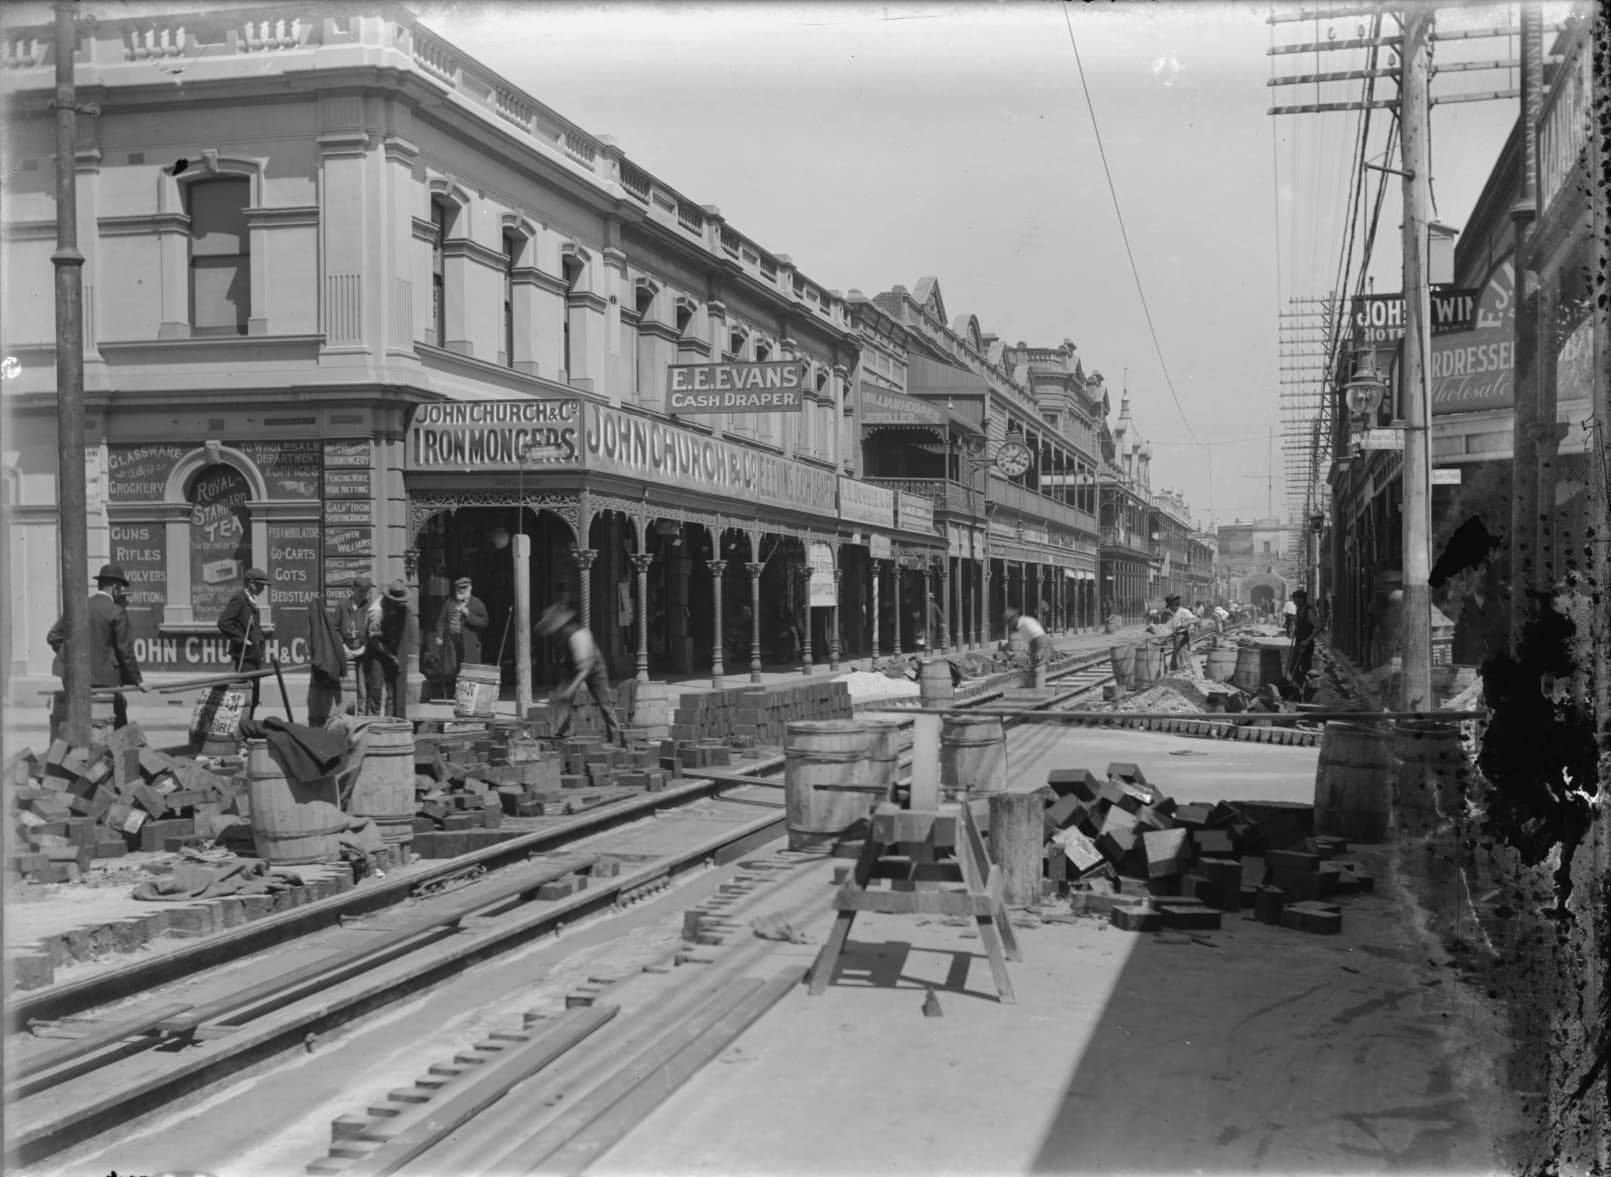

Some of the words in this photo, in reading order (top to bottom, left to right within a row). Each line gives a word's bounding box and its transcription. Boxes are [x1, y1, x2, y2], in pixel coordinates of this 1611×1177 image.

[1432, 370, 1507, 403] holesale
[671, 394, 720, 407] CASH
[724, 392, 799, 406] DRAPER.
[415, 403, 469, 424] JOHN
[470, 402, 549, 423] CHURCH
[548, 407, 559, 421] &
[253, 441, 320, 452] WHOLESALE
[586, 403, 649, 472] JOHN
[650, 422, 730, 491] CHURCH
[109, 446, 182, 469] GLASSWARE
[256, 452, 320, 464] DEPARTMENT
[198, 476, 235, 501] ROYAL
[192, 492, 247, 525] STANDARD
[111, 527, 150, 540] GUNS
[205, 515, 244, 541] TEA
[326, 530, 360, 545] SHERWIN
[116, 547, 161, 560] RIFLES
[271, 547, 316, 560] GO-CARTS
[124, 569, 167, 581] VOLVERS
[275, 567, 307, 581] COTS
[134, 637, 177, 663] OHN
[185, 637, 279, 664] CHUH
[280, 646, 291, 664] &
